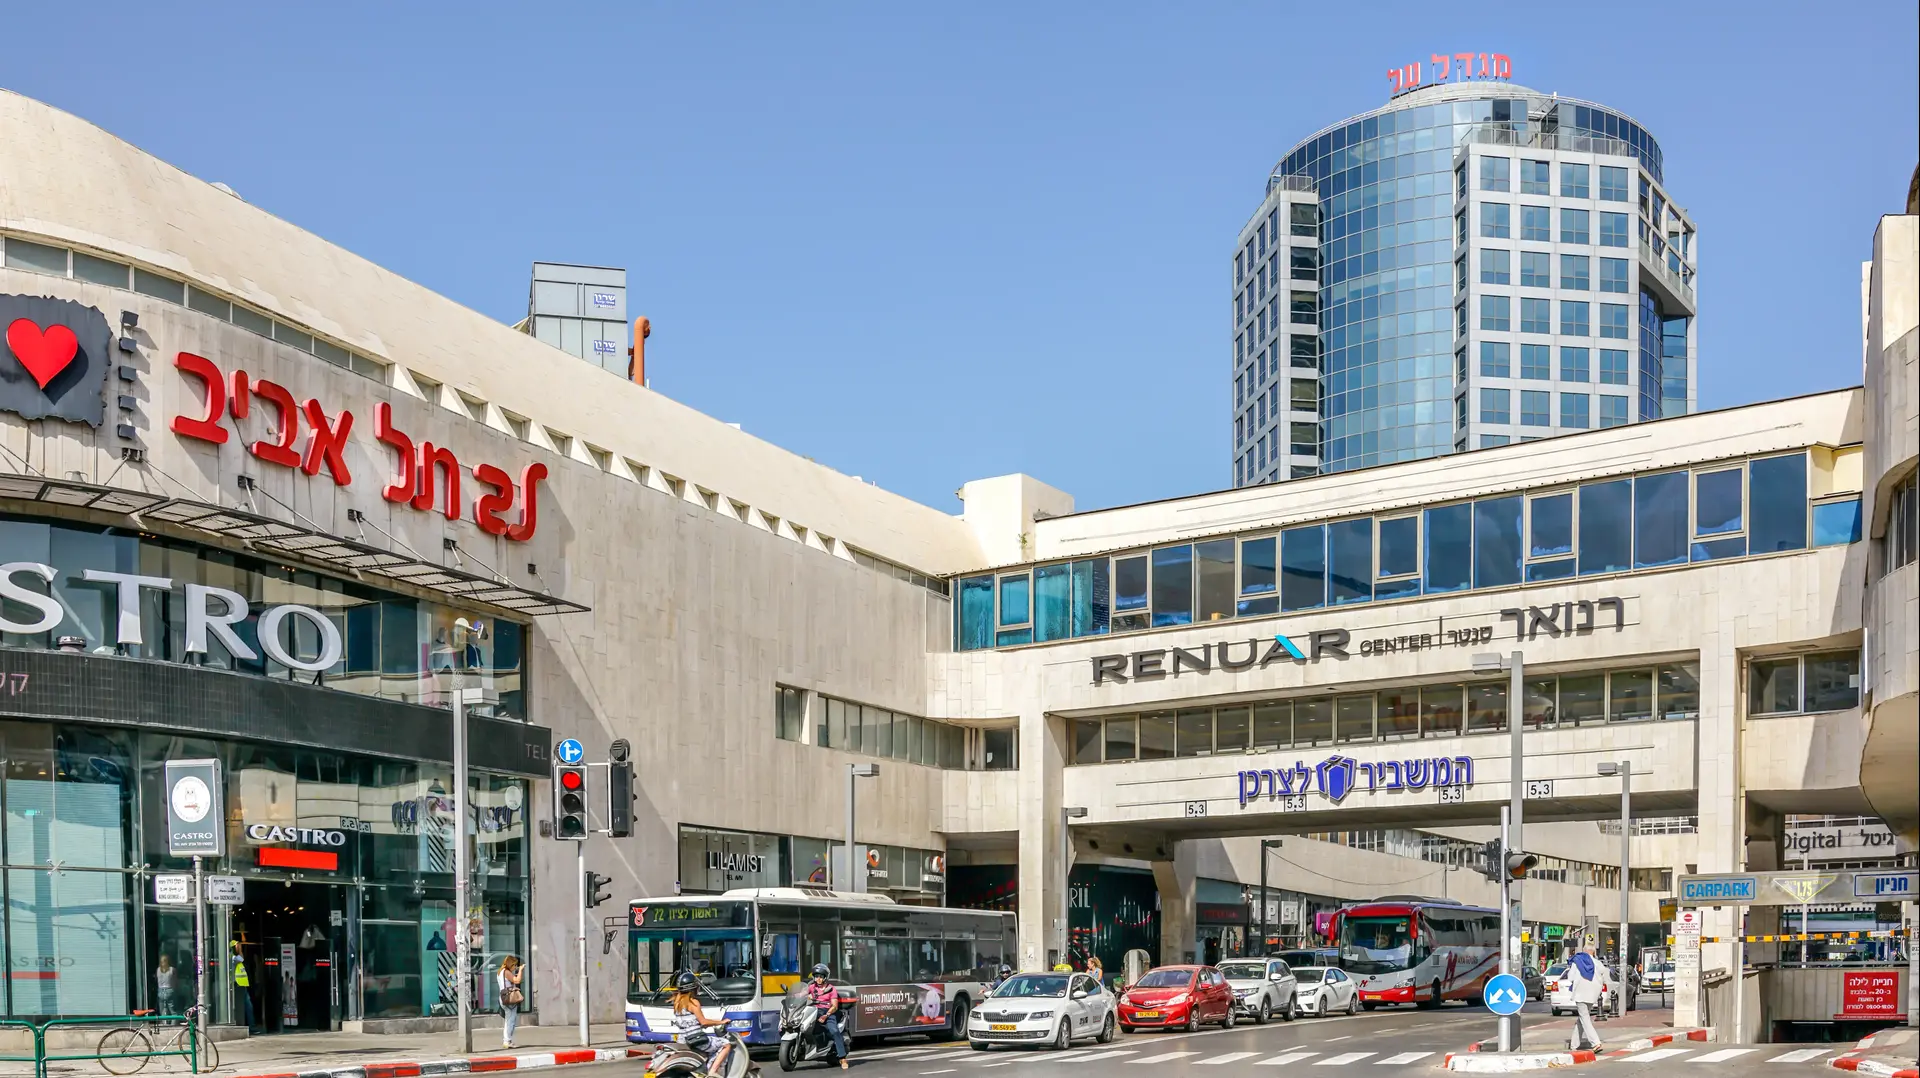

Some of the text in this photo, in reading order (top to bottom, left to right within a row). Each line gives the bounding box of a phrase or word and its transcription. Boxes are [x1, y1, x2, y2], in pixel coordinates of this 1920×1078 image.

[1387, 52, 1512, 94] מגדל על
[594, 293, 616, 302] שרון
[169, 350, 354, 487] אביב
[374, 401, 461, 521] תל
[1447, 597, 1624, 646] רנואר סנטר
[1091, 628, 1432, 686] RENUAR CENTER
[525, 743, 548, 760] TEL
[1238, 756, 1475, 805] המשביר לצרכן
[1442, 788, 1461, 800] 5.3
[1530, 784, 1550, 796] 5.3
[1188, 804, 1205, 814] 5.3
[1286, 798, 1304, 809] 5.3
[173, 832, 213, 840] CASTRO
[248, 824, 346, 846] CASTRO
[1784, 829, 1842, 853] Digital
[1860, 829, 1895, 846] גיטל
[708, 851, 766, 873] LILAMIST
[1686, 882, 1750, 898] CARPARK
[1796, 880, 1813, 898] 1.75
[1875, 877, 1909, 895] חניון
[669, 907, 689, 920] לציון
[691, 907, 718, 920] ראשון
[1849, 977, 1893, 986] חניית לילה
